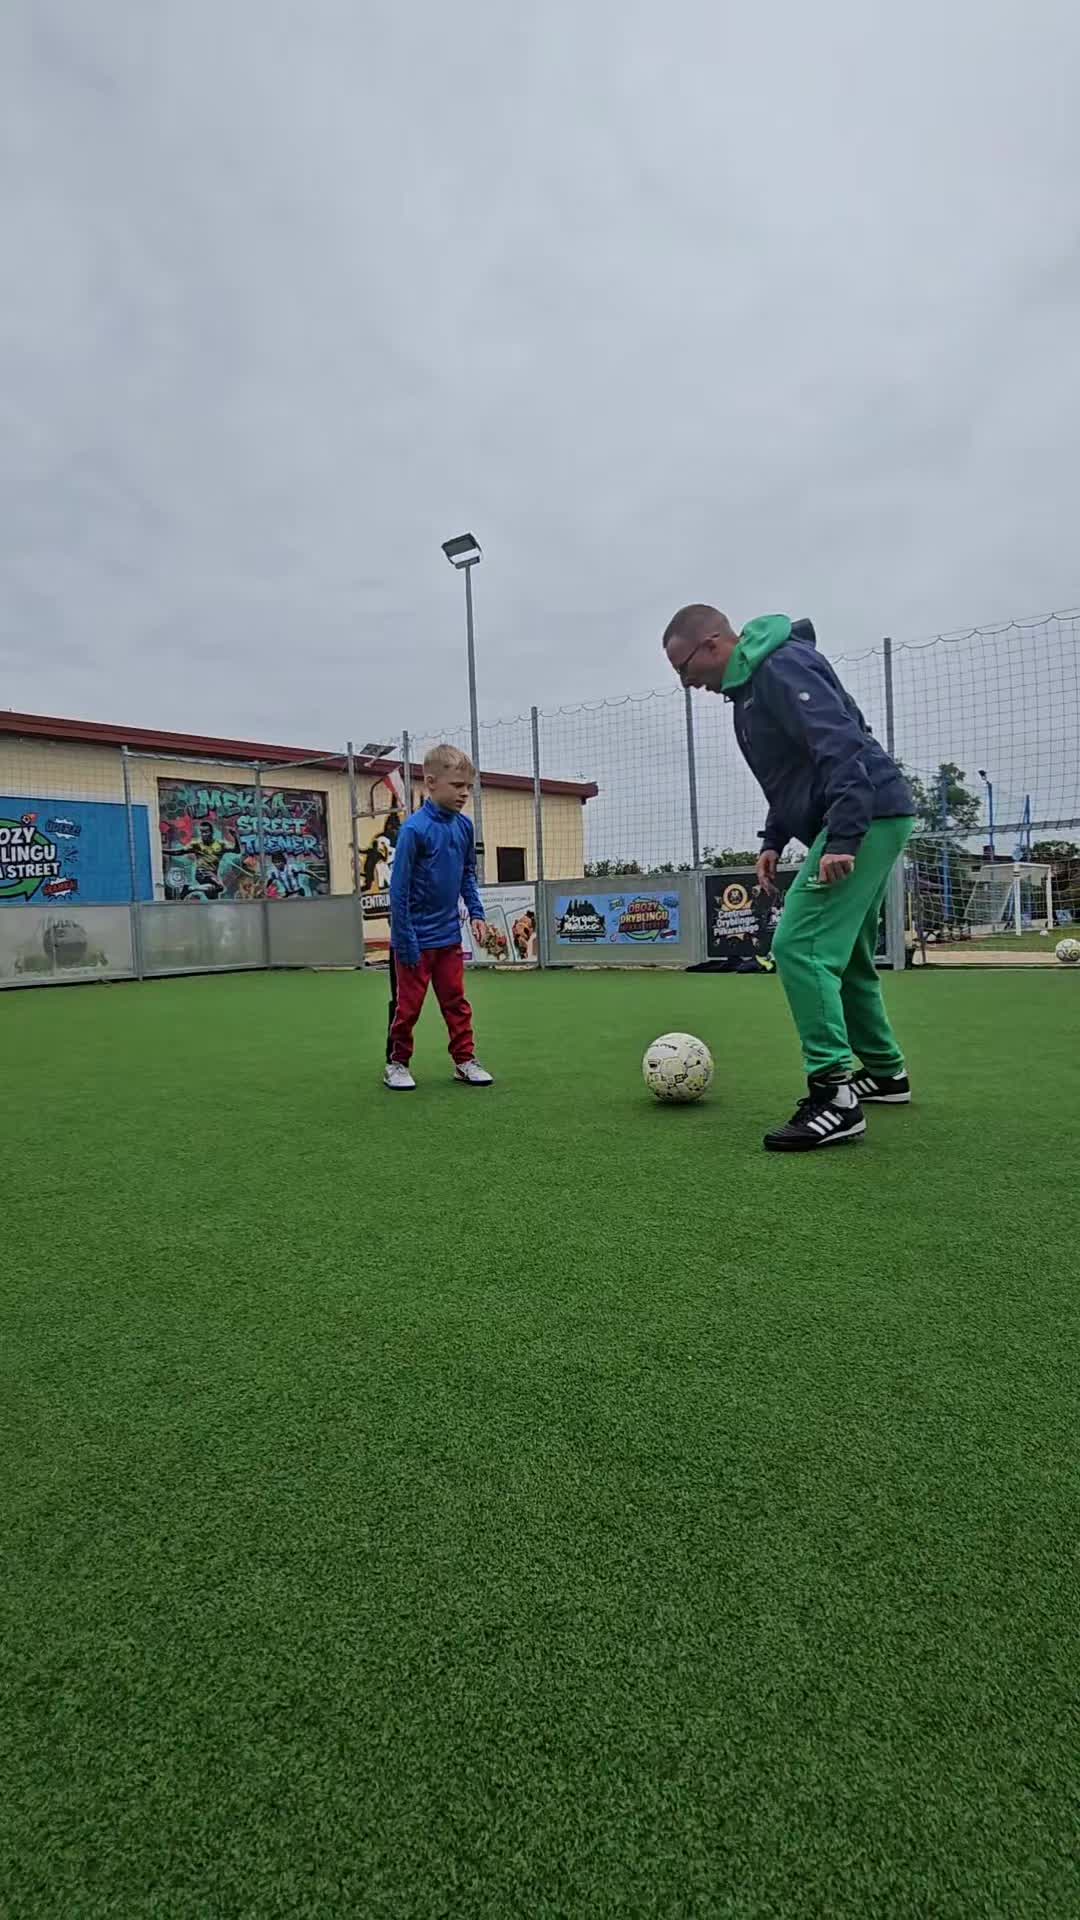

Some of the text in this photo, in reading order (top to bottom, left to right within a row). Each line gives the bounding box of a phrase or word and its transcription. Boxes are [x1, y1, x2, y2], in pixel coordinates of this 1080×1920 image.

[194, 789, 291, 817] MEKKA
[236, 815, 306, 833] STREET
[7, 862, 60, 879] STREET
[360, 895, 391, 909] CENTRU
[629, 902, 658, 912] OBOZY
[620, 911, 668, 924] DRYBLINGU
[718, 909, 753, 919] Centrum
